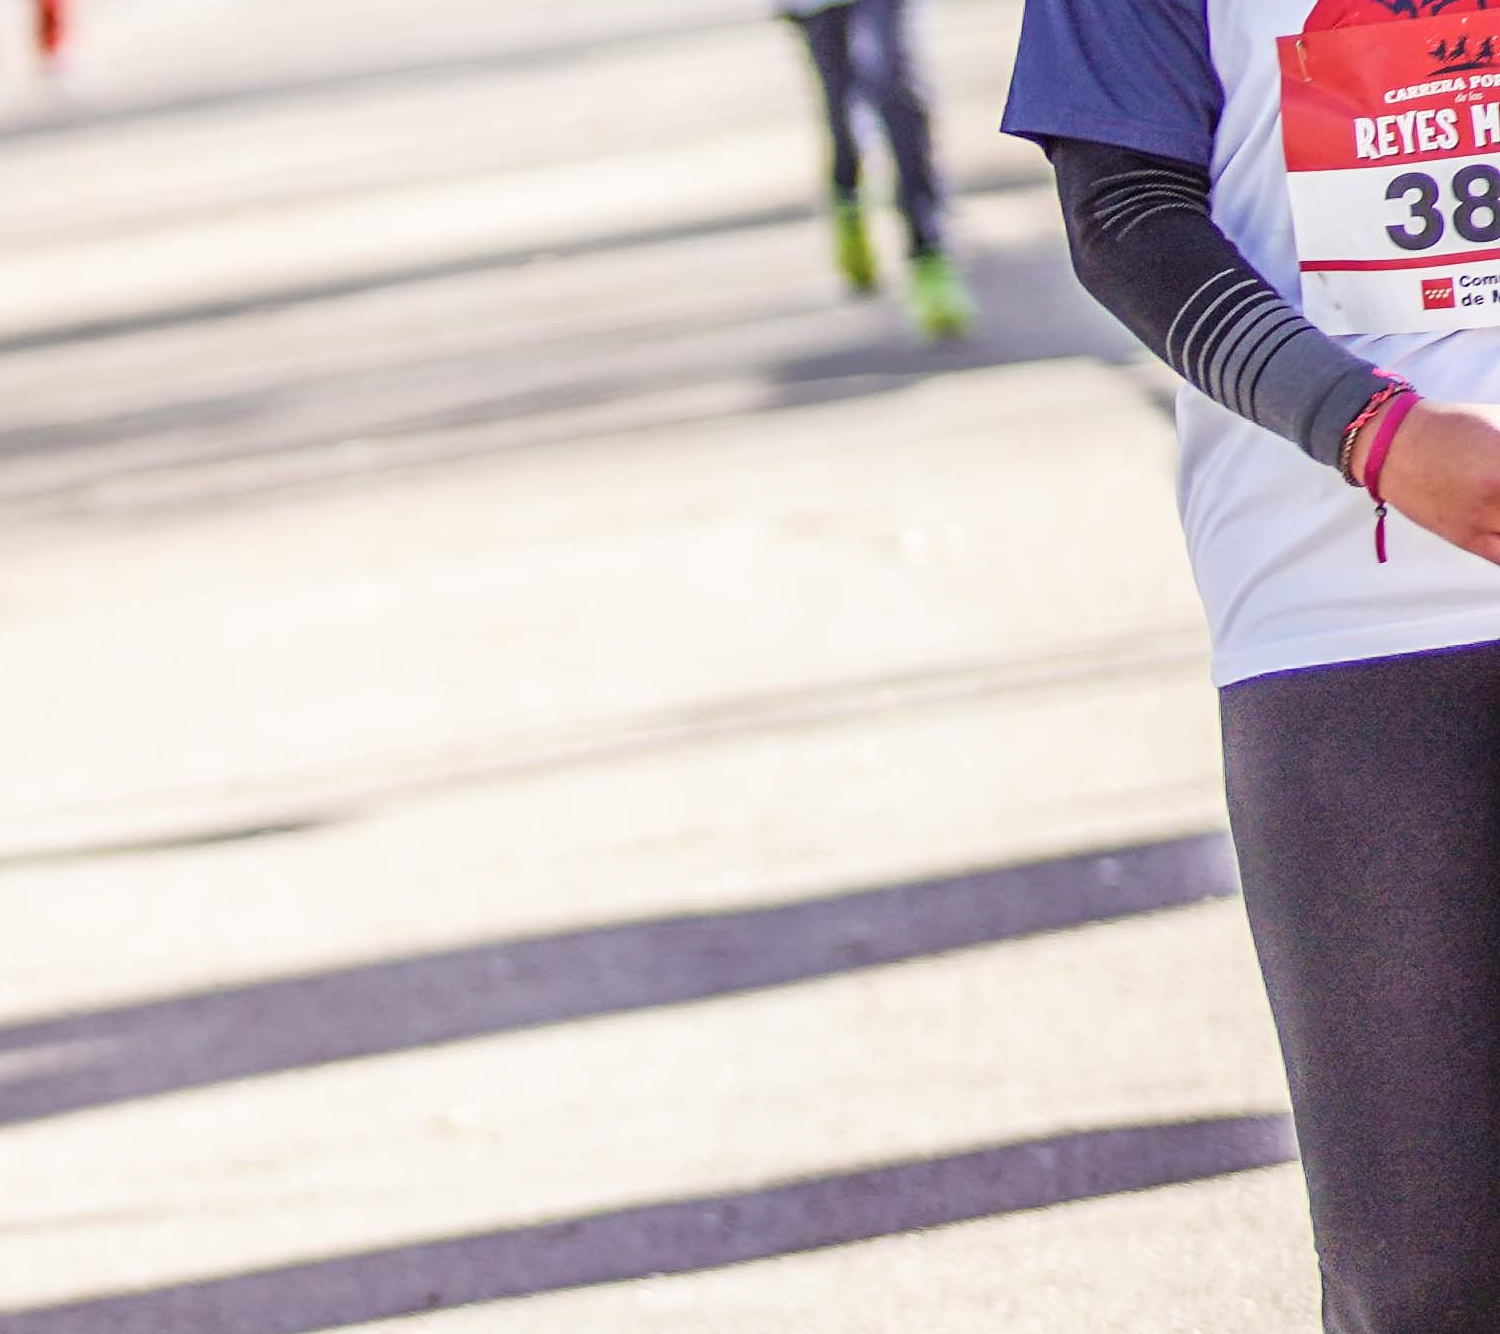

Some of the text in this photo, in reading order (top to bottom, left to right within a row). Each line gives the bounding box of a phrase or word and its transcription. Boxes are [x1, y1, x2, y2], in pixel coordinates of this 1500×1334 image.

[1384, 77, 1467, 104] CARRERA
[1353, 108, 1459, 160] REYES
[1461, 294, 1485, 307] de
